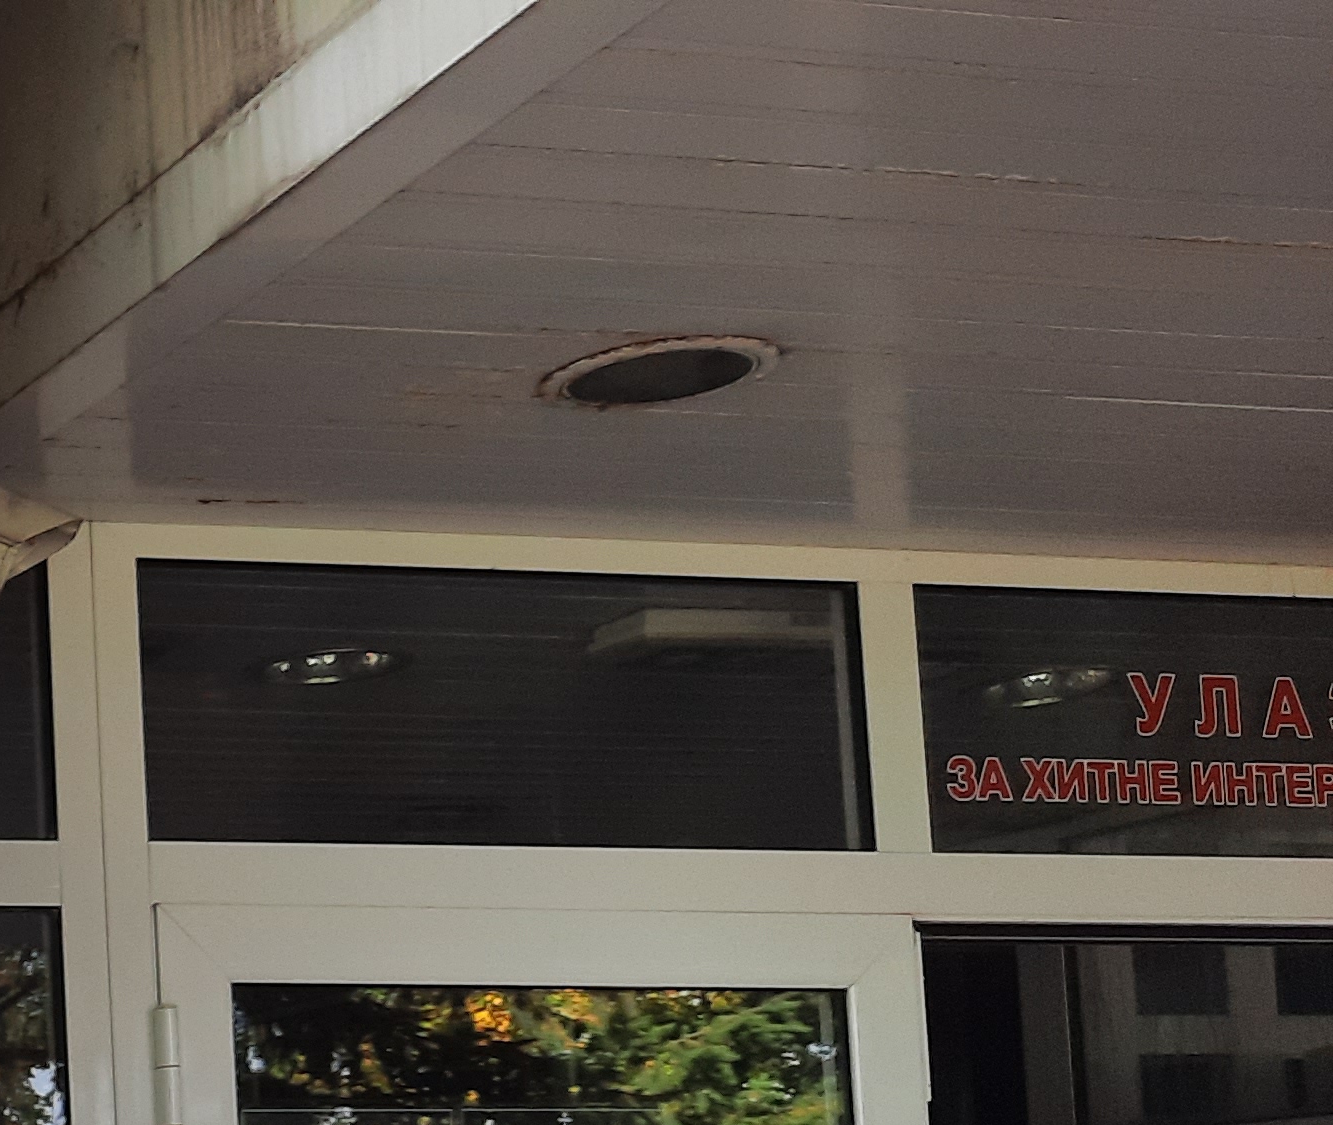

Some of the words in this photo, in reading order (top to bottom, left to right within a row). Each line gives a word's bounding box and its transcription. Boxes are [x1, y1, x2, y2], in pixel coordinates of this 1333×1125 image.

[1127, 672, 1333, 739] УЛА
[946, 755, 1013, 802] ЗА
[1020, 757, 1181, 806] ХИТНЕ
